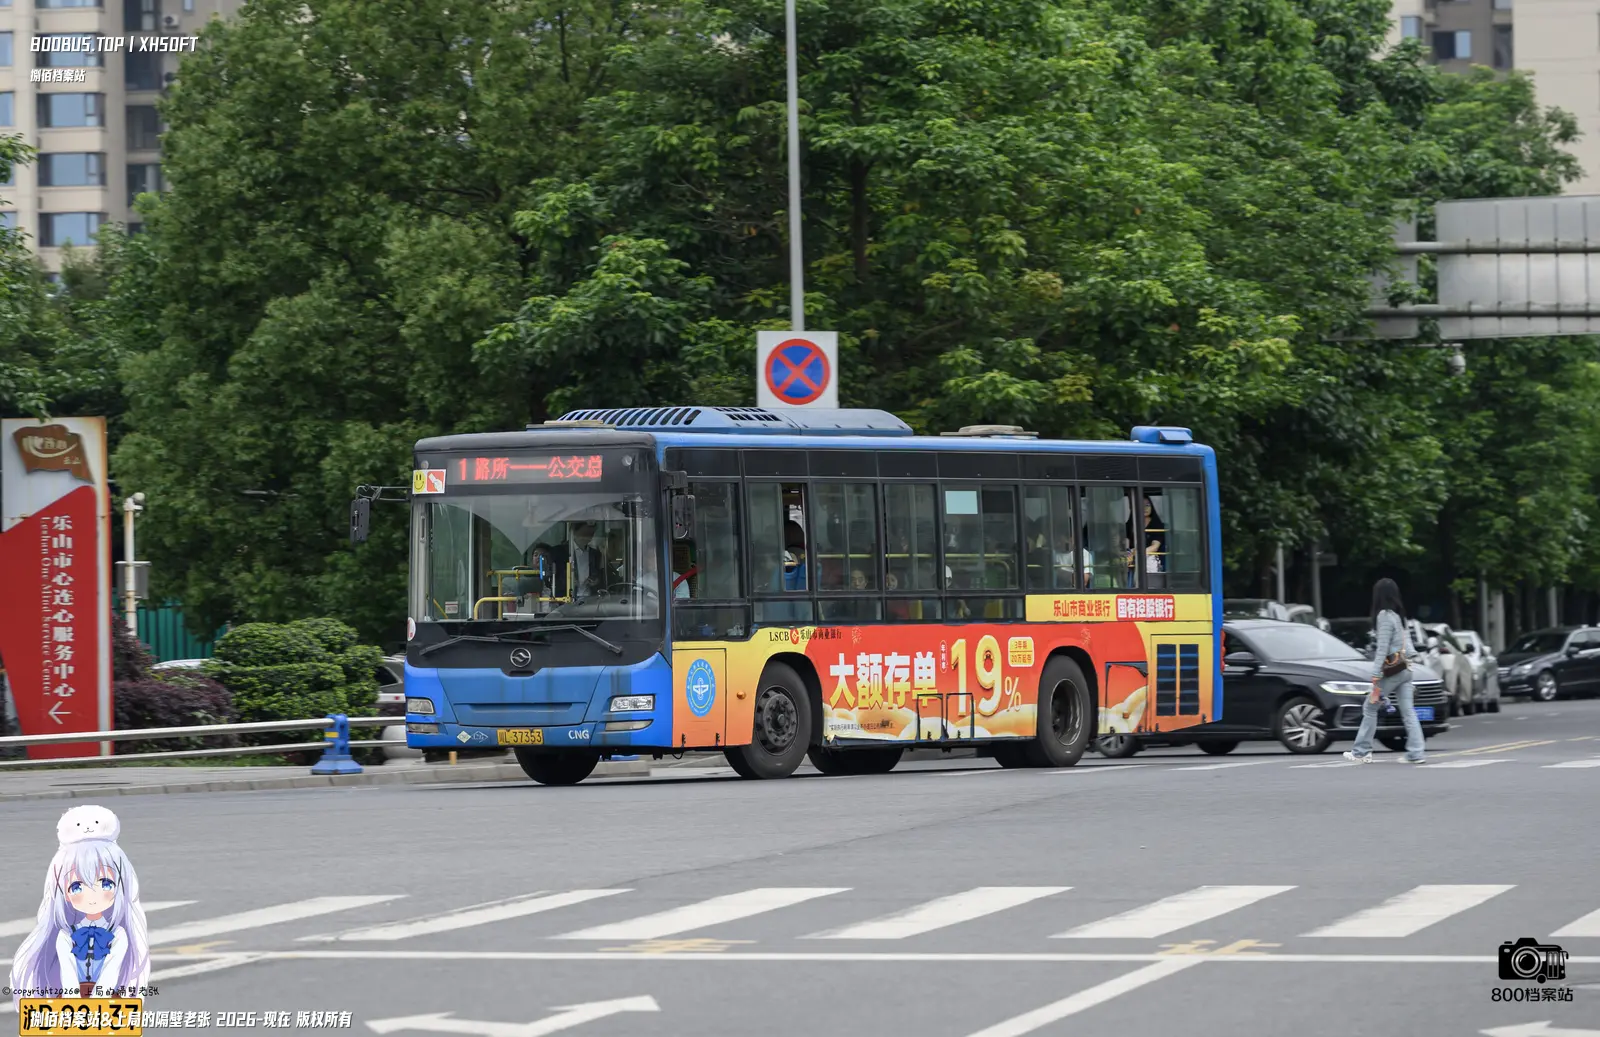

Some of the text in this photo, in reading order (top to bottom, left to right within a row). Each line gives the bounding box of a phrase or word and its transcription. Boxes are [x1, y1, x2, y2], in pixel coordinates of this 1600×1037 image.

[41, 557, 52, 580] One
[52, 515, 75, 697] 乐山市心连心服务中心
[1053, 597, 1173, 618] 乐山市商业银行 国有控股银行
[769, 631, 790, 642] LSCB
[800, 628, 842, 640] 乐山市商业银行
[829, 651, 938, 710] 大额存单
[568, 729, 590, 740] CNG
